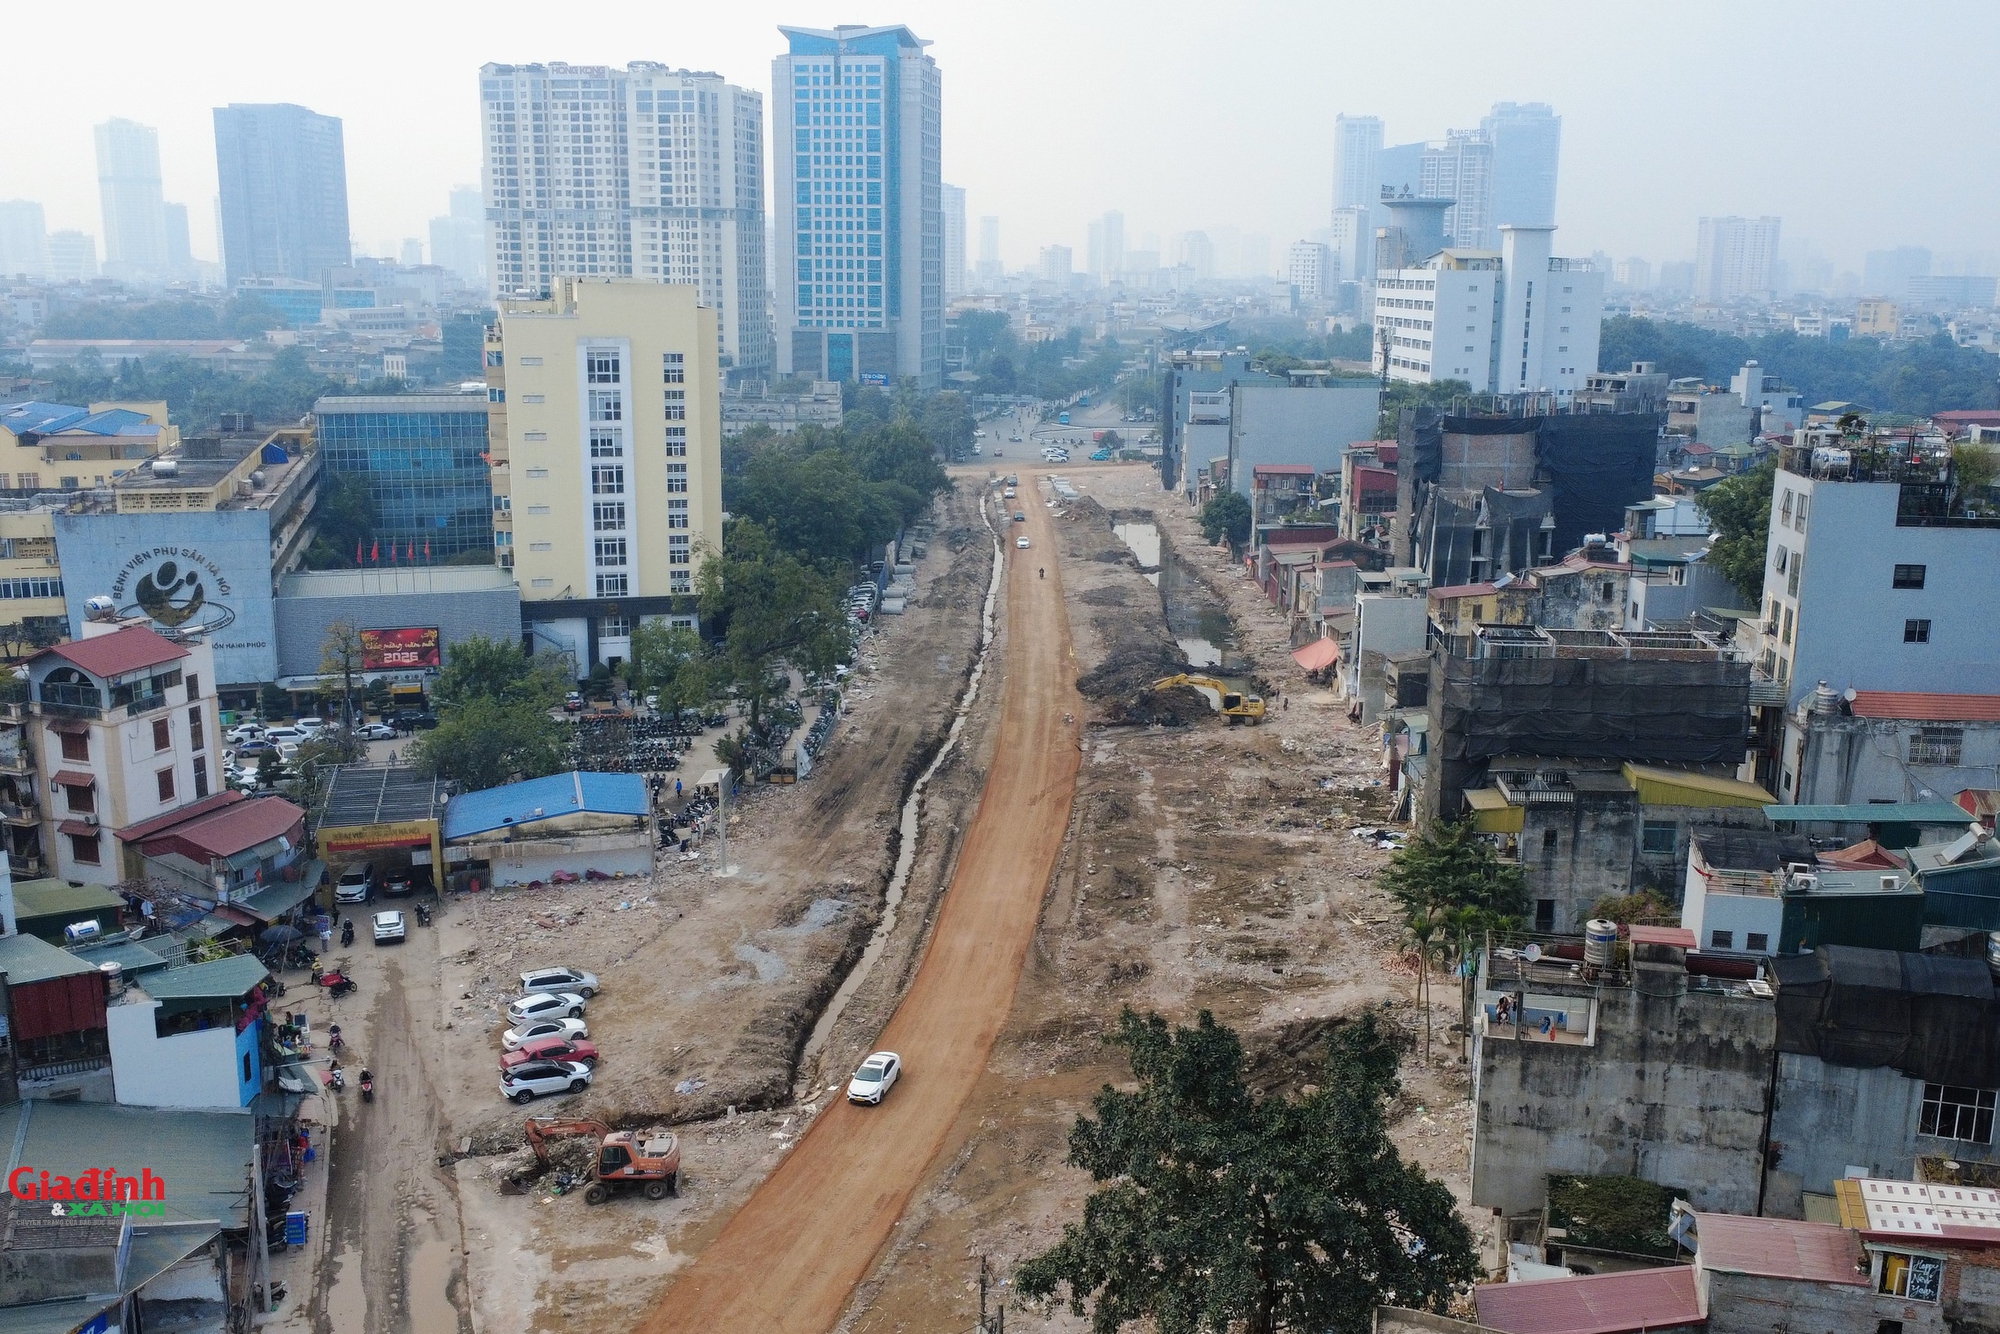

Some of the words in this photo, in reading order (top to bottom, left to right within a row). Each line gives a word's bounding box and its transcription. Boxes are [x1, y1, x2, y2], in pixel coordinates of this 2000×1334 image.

[551, 65, 578, 74] HONG
[580, 65, 606, 74] KONG
[113, 569, 130, 600] BỆNH
[126, 550, 152, 570] VIỆN
[153, 547, 178, 557] PHỤ
[181, 548, 206, 564] SẢN
[204, 561, 221, 577] HÀ
[216, 577, 231, 597] NỘI
[246, 641, 267, 649] PHÚC
[383, 652, 418, 663] 2026
[1912, 1259, 1941, 1278] Happy
[1910, 1273, 1933, 1284] New
